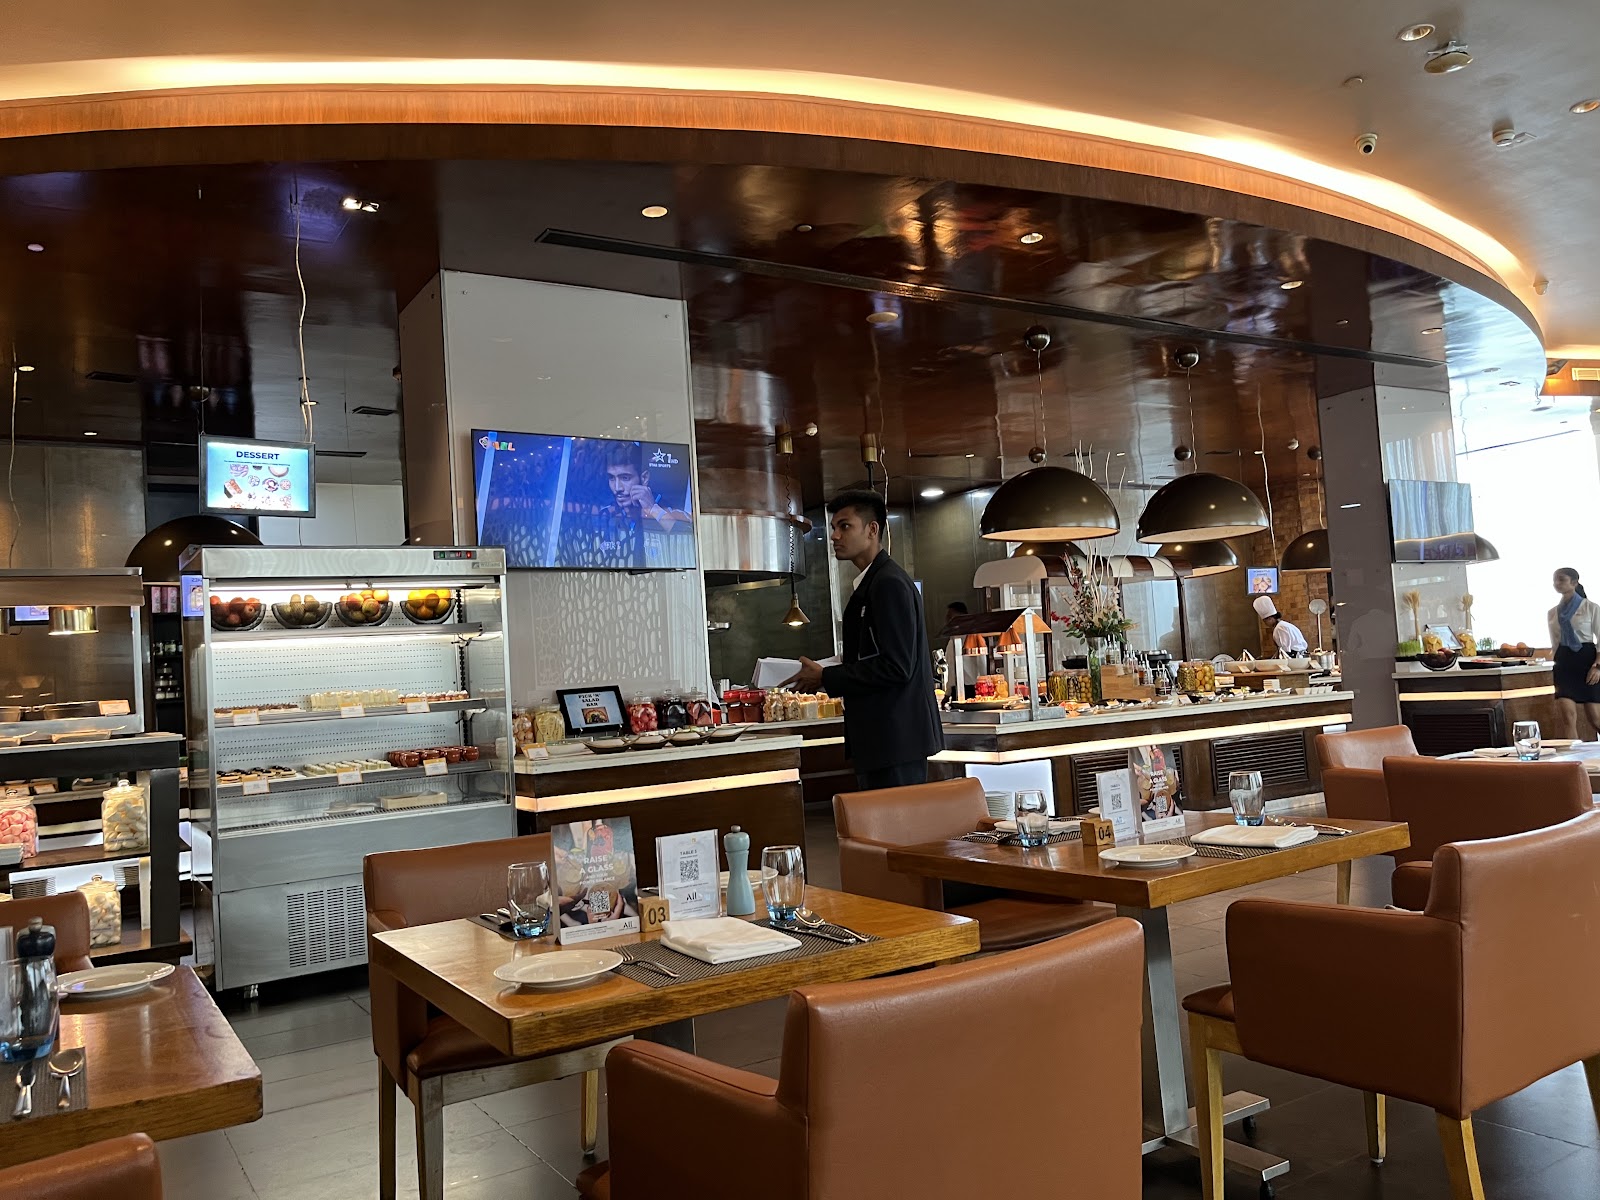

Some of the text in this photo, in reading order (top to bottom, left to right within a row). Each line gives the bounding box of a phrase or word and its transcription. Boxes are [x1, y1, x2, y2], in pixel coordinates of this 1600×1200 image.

[236, 451, 280, 460] DESSERT
[1098, 825, 1111, 840] 04
[584, 855, 608, 864] RAISE
[587, 863, 614, 873] GLASS
[648, 906, 666, 925] 03
